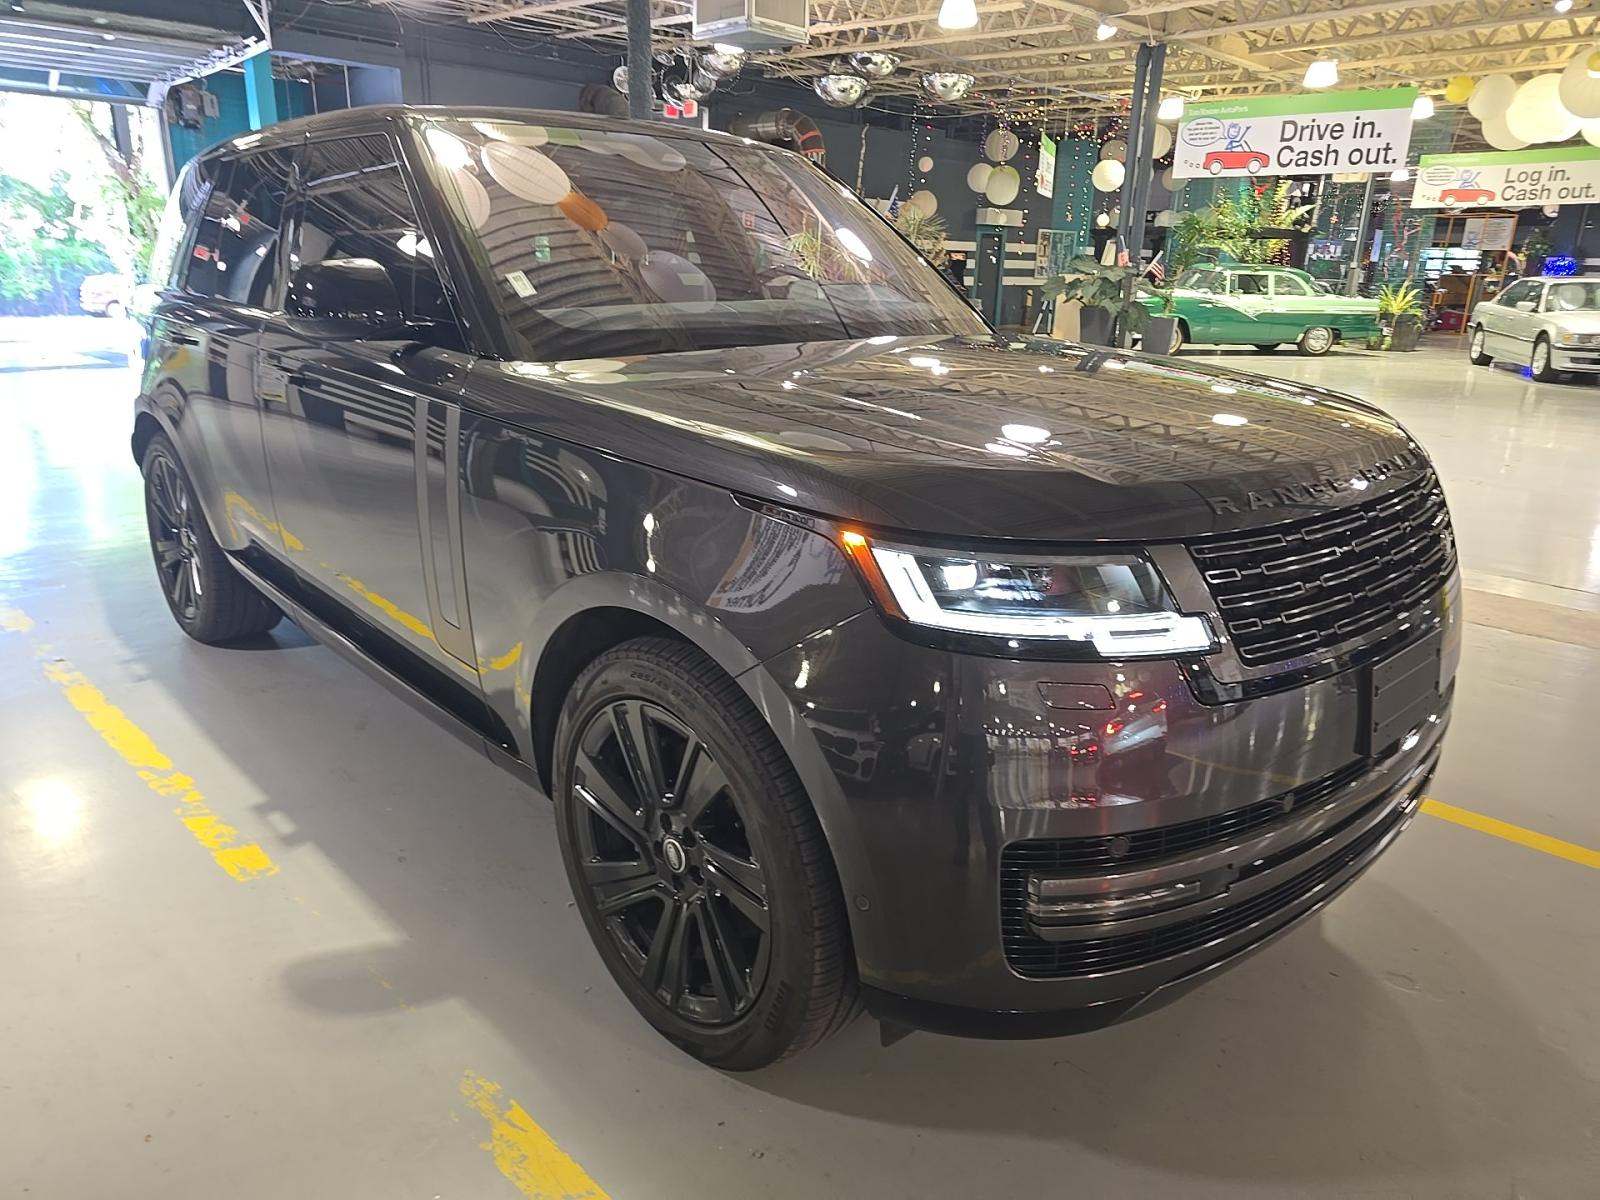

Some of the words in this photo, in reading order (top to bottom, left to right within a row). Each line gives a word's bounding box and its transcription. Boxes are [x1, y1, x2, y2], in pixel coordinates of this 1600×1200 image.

[1280, 118, 1344, 142] Drive
[1352, 116, 1382, 139] in.
[1277, 144, 1339, 168] Cash
[1348, 142, 1397, 165] out.
[1504, 167, 1543, 186] Log
[1547, 165, 1570, 182] in.
[1501, 184, 1551, 201] Cash
[1557, 183, 1596, 200] out.
[1206, 478, 1349, 515] RANGE
